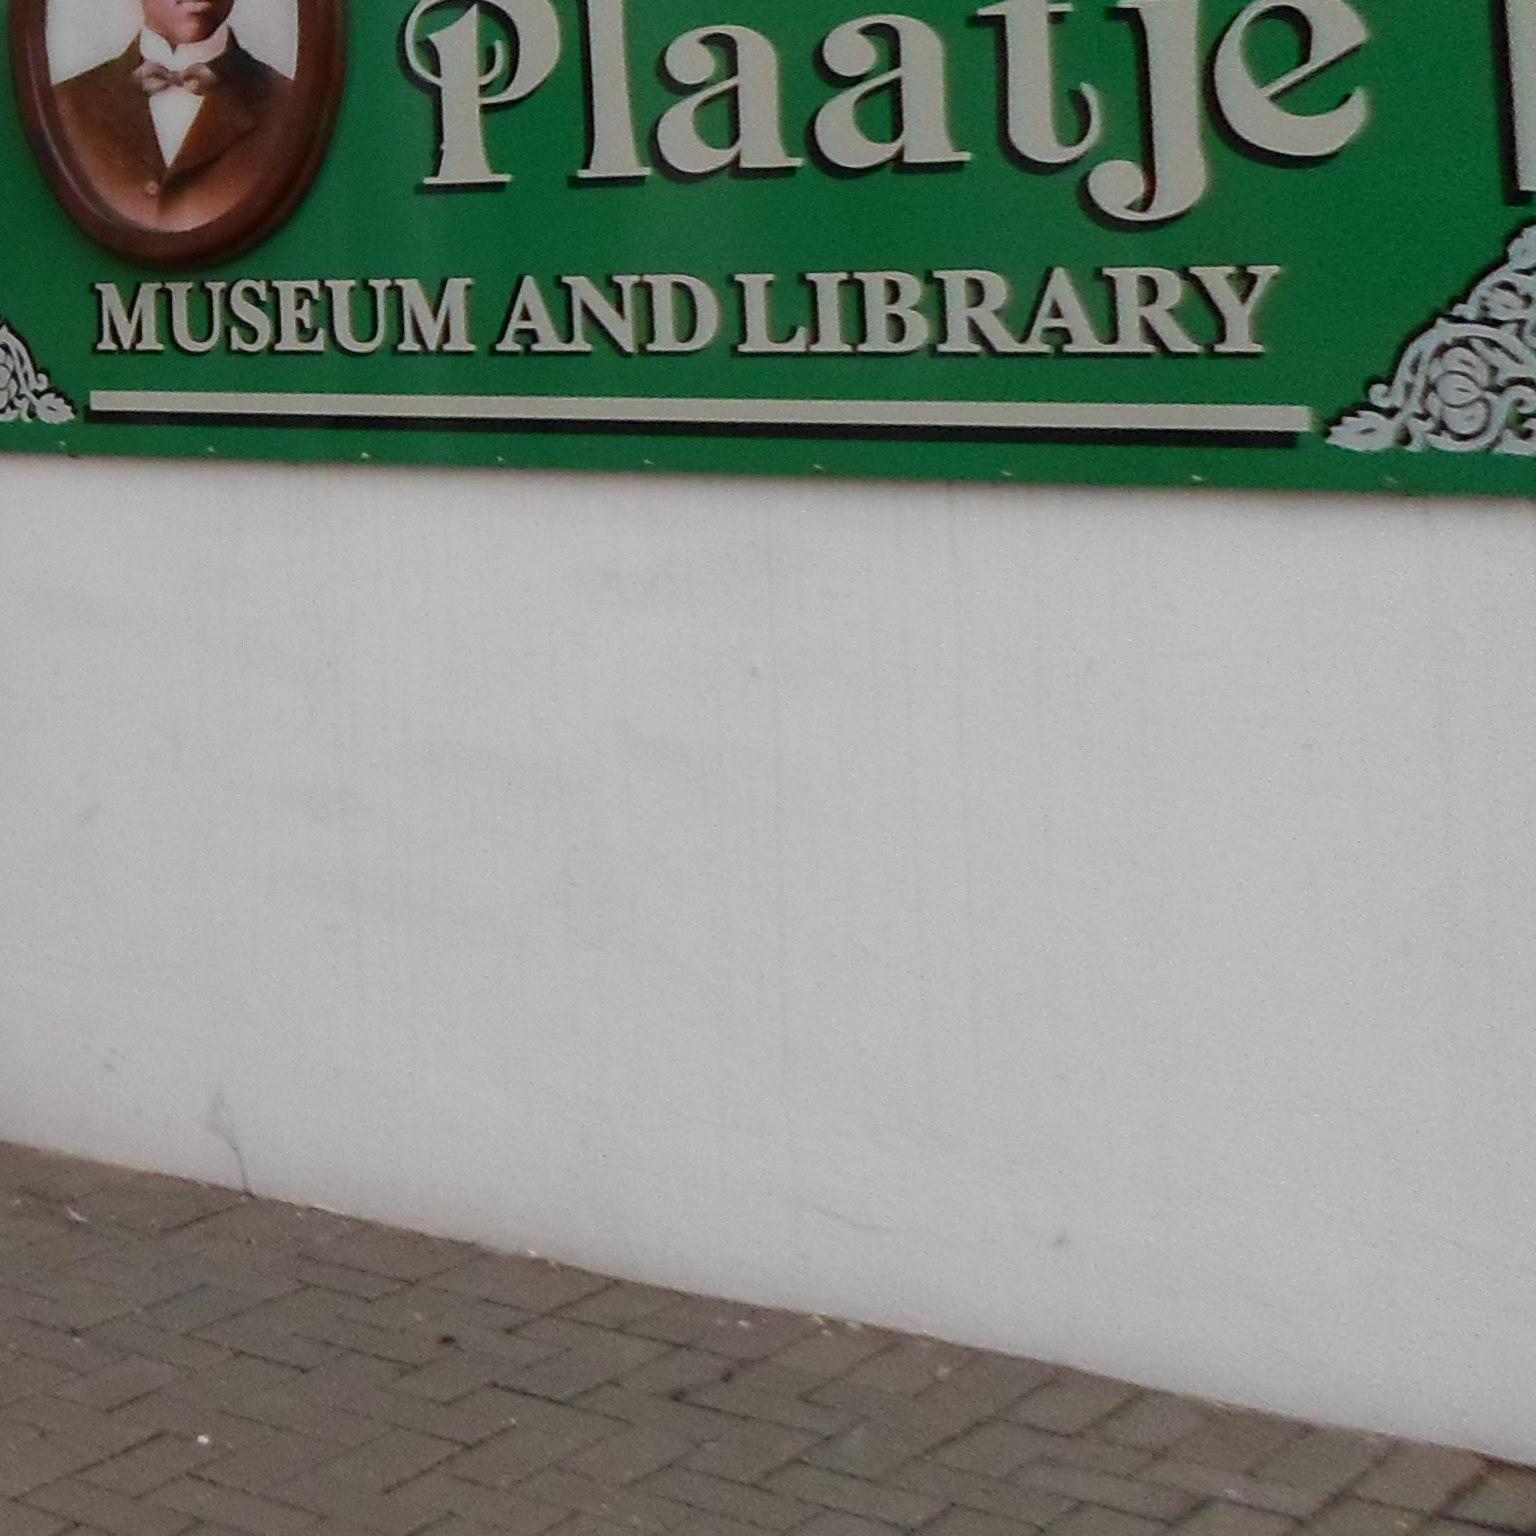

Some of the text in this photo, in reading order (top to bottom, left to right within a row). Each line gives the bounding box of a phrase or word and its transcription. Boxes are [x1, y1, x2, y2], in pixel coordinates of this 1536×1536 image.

[94, 265, 1281, 354] MUSEUM AND LIBRARY
